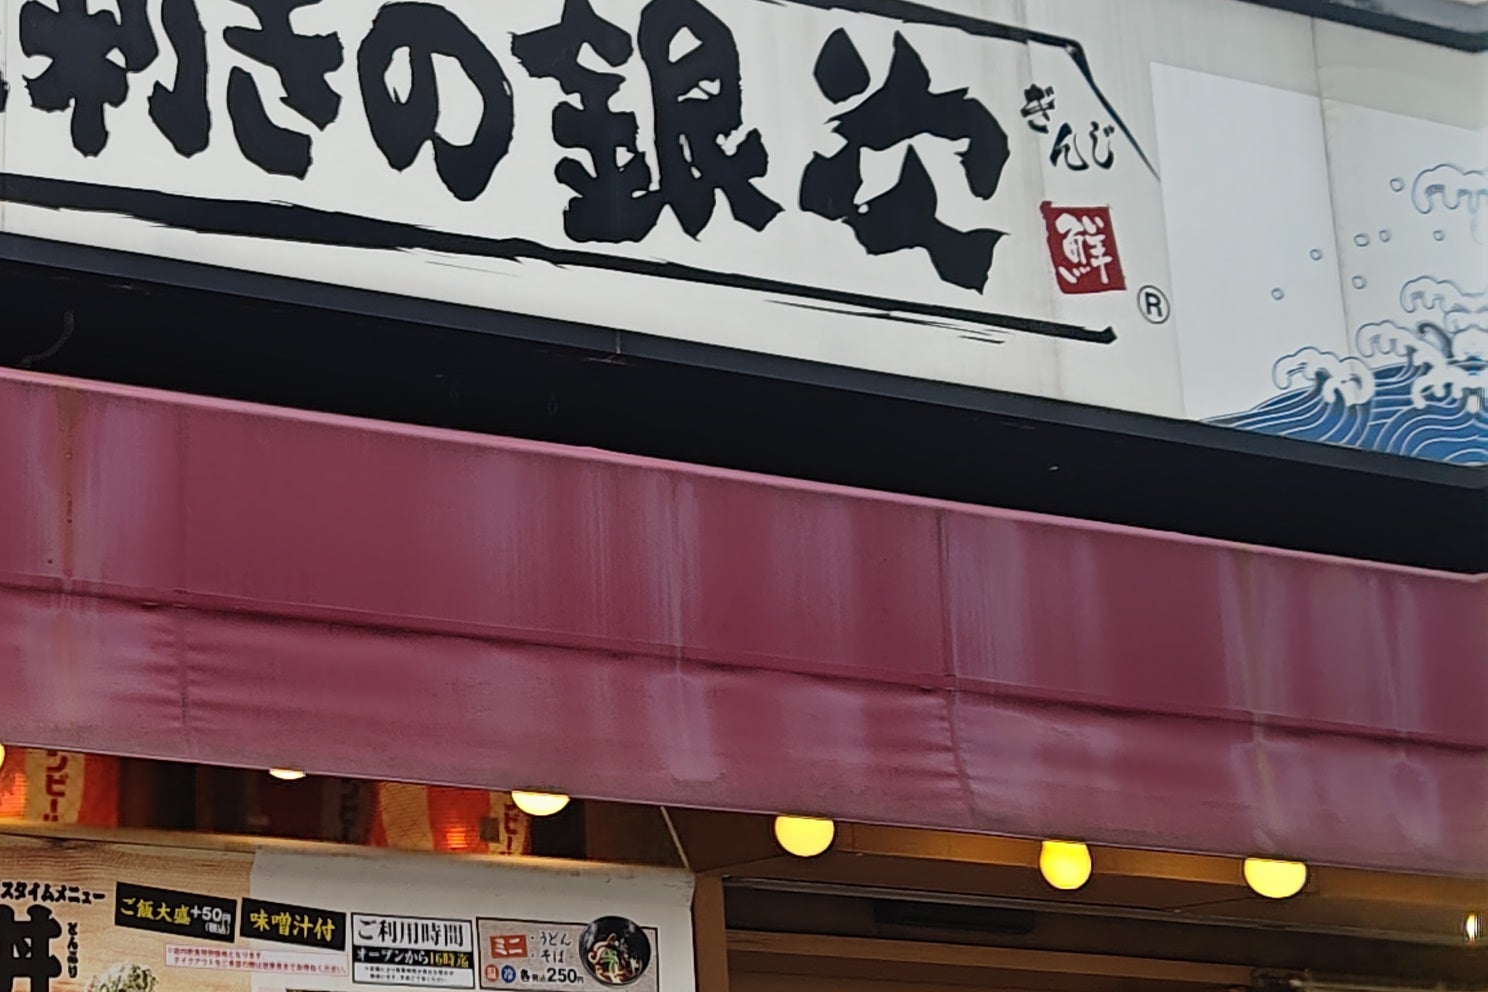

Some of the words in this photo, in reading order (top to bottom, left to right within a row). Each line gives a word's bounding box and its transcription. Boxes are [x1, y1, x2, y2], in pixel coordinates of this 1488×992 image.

[1020, 84, 1116, 172] ぎんじ
[1053, 209, 1116, 287] 鮮
[249, 909, 336, 942] 味噌汁付
[357, 919, 464, 948] ご利用時間
[494, 937, 523, 956] ミニ
[540, 948, 565, 964] そば
